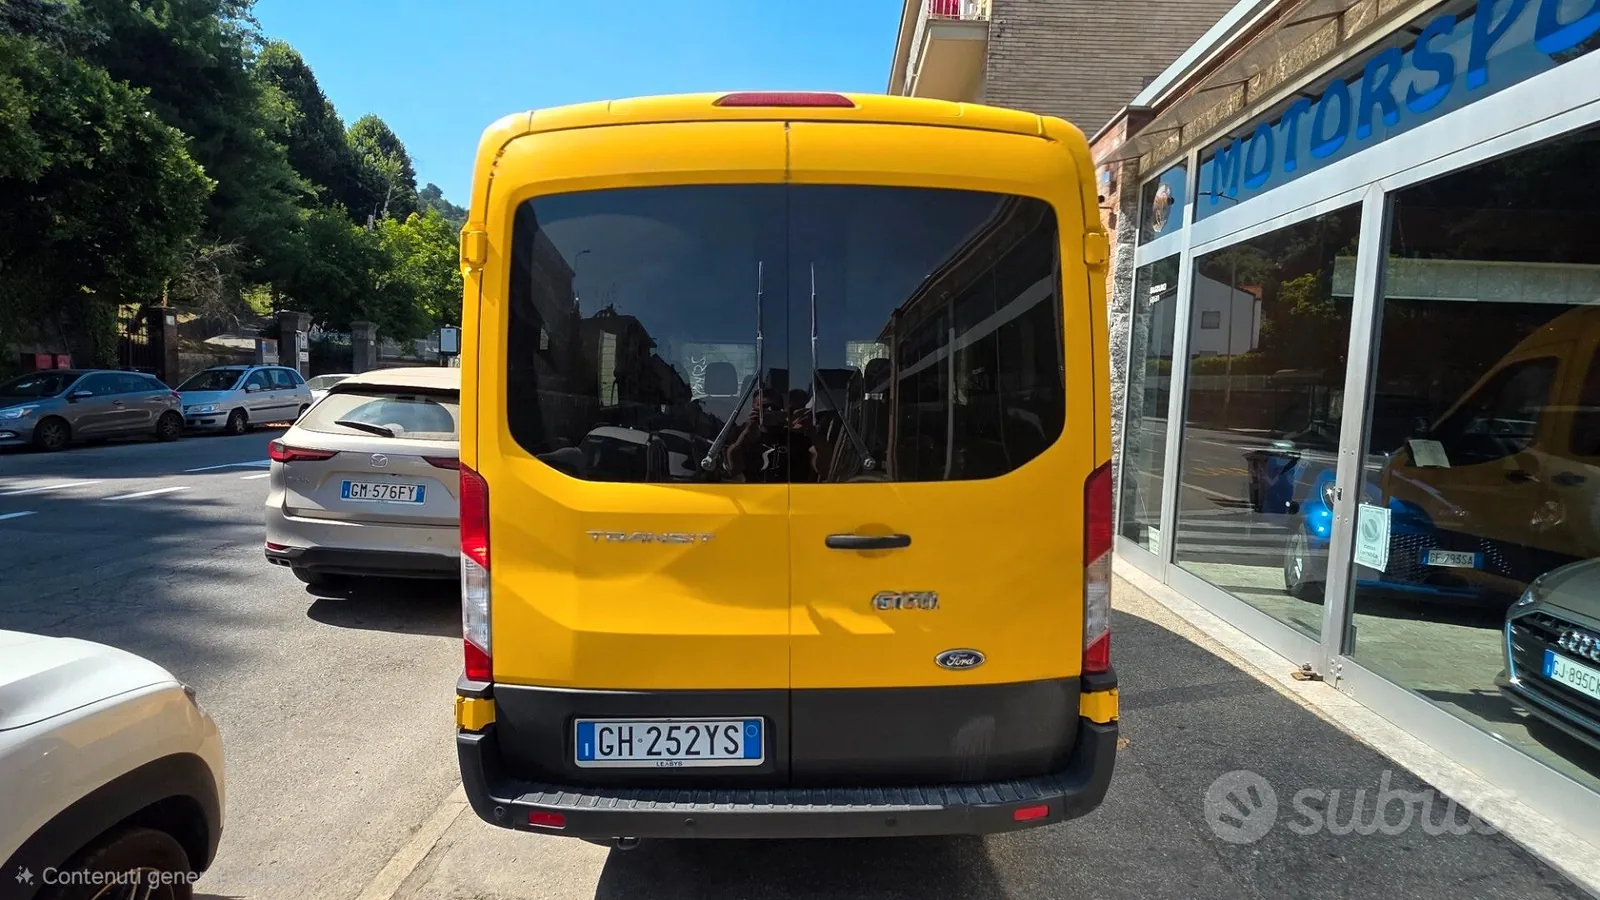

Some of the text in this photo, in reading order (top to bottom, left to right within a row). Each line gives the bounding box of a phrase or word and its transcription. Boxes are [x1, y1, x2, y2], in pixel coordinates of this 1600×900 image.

[351, 484, 368, 497] GM
[599, 724, 739, 757] GH 252YS
